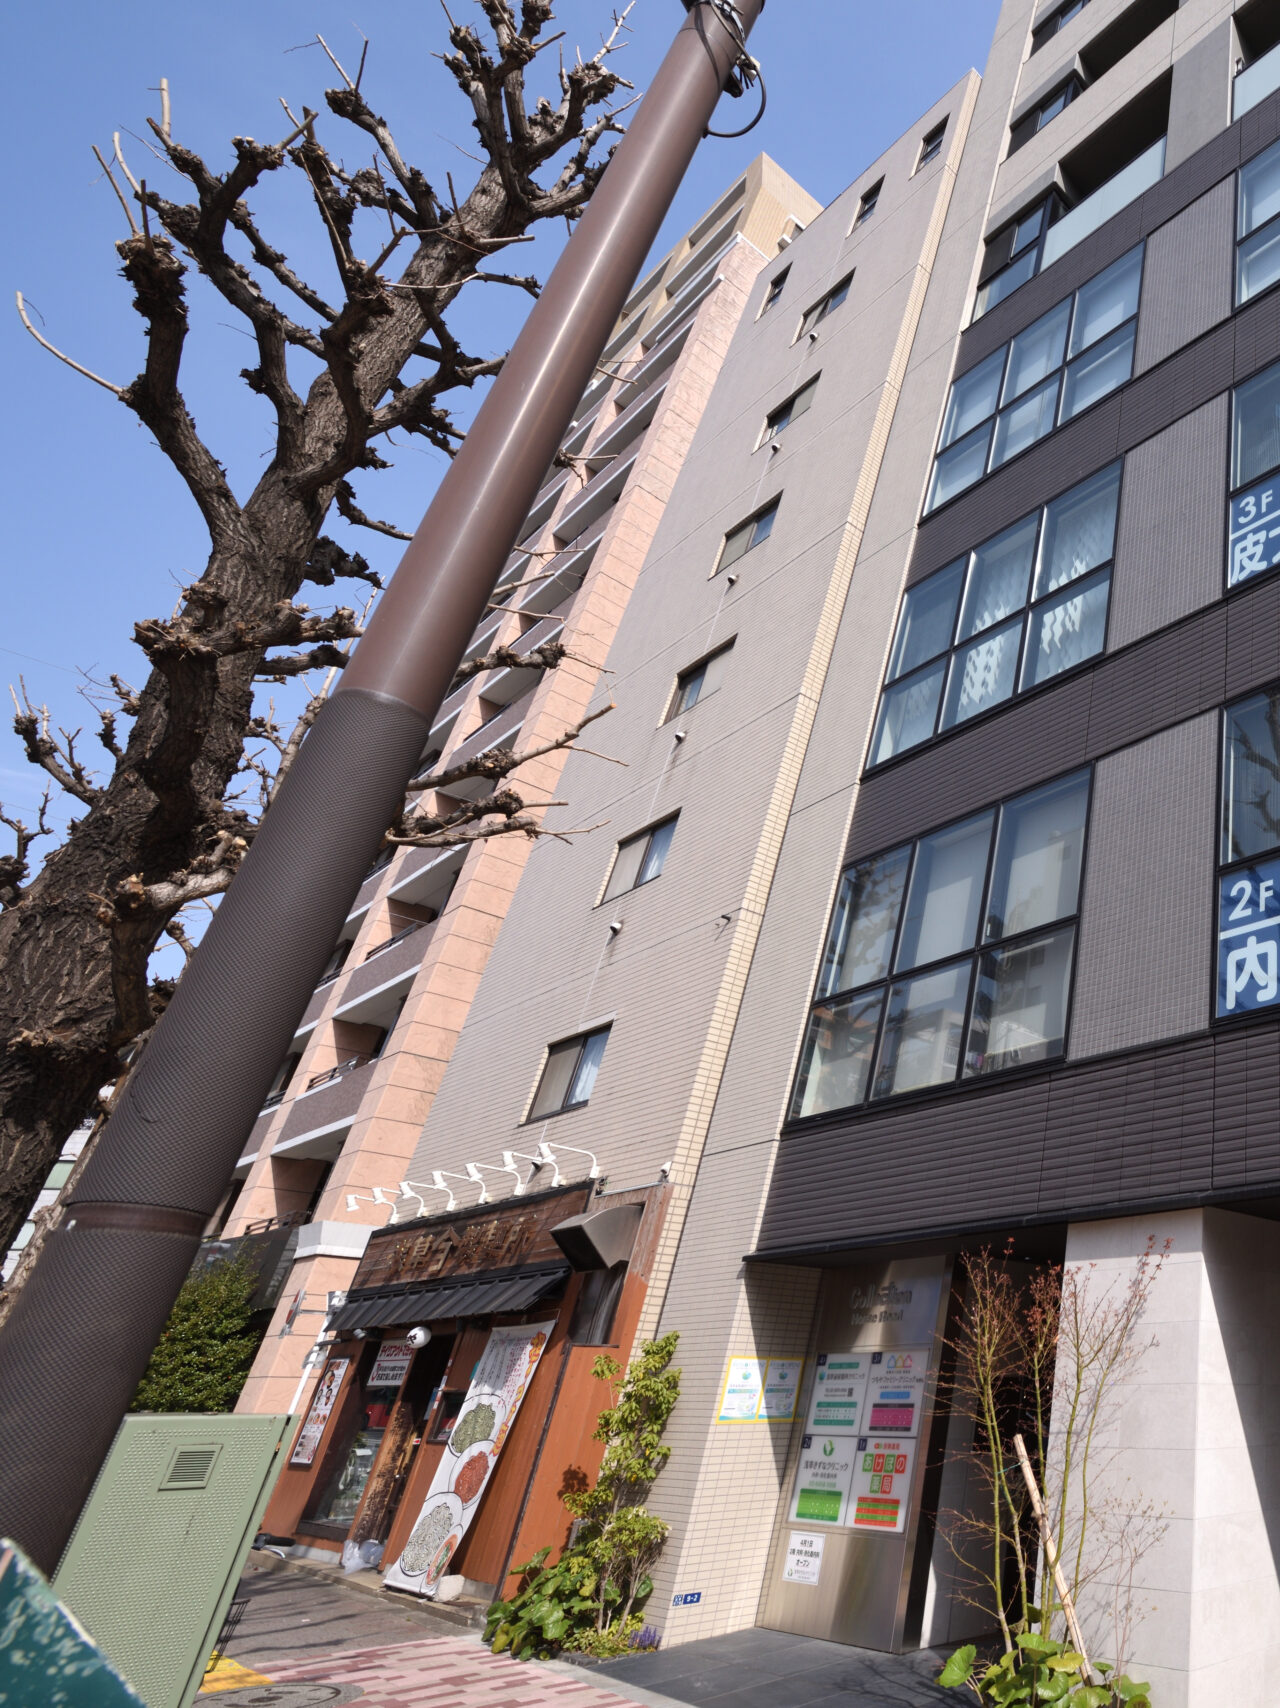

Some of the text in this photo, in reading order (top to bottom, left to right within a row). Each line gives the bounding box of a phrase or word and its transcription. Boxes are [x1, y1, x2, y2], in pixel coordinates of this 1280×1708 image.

[1238, 489, 1273, 524] 3F
[1228, 879, 1275, 922] 2F
[864, 1455, 906, 1472] あけぼの
[872, 1476, 892, 1492] 薬局
